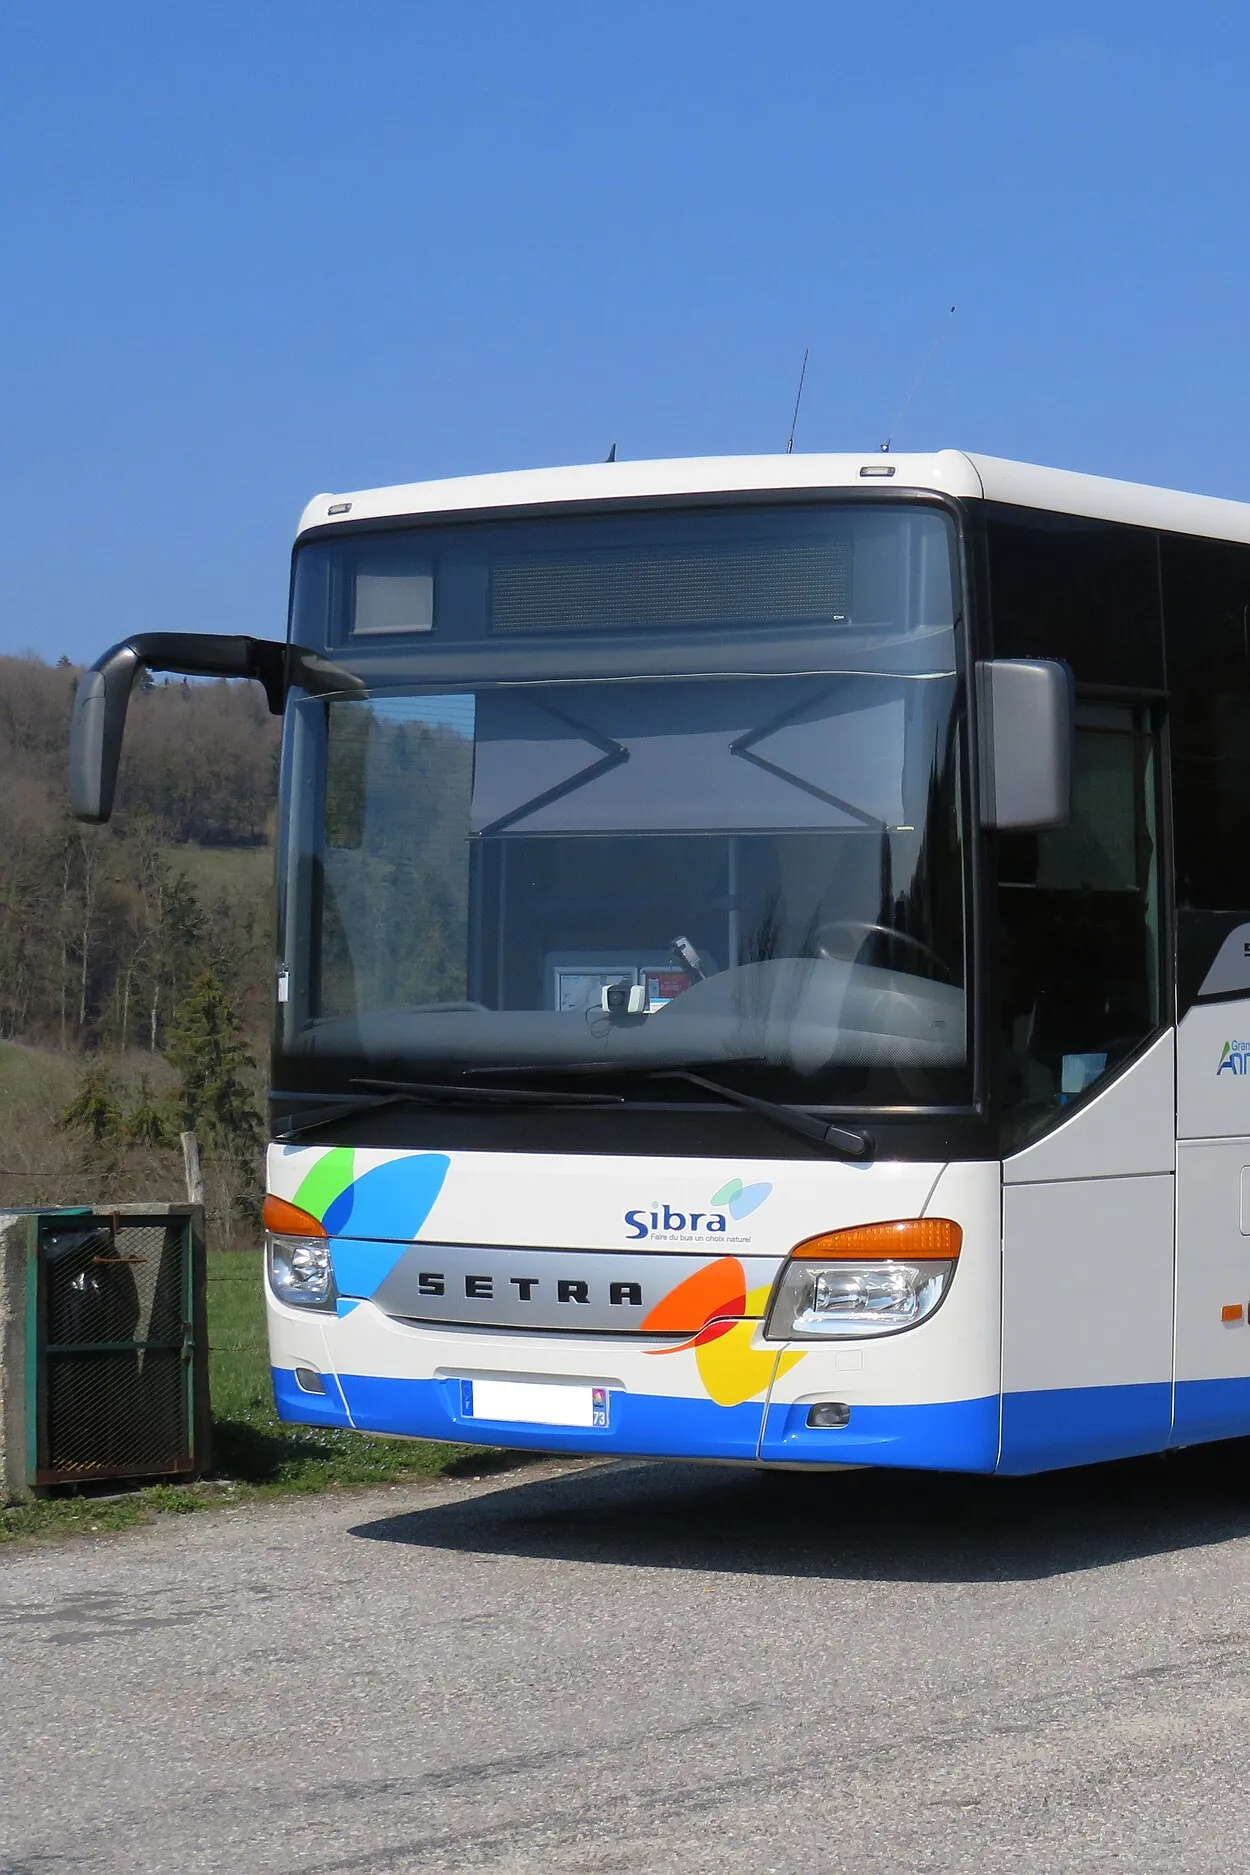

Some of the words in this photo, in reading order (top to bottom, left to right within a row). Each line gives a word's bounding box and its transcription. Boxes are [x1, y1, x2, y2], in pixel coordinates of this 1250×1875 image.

[650, 1233, 668, 1241] Faire
[680, 1234, 693, 1242] bus
[705, 1234, 725, 1243] choix
[726, 1235, 752, 1244] naturel
[418, 1272, 643, 1306] SETRA
[593, 1411, 606, 1426] 73
